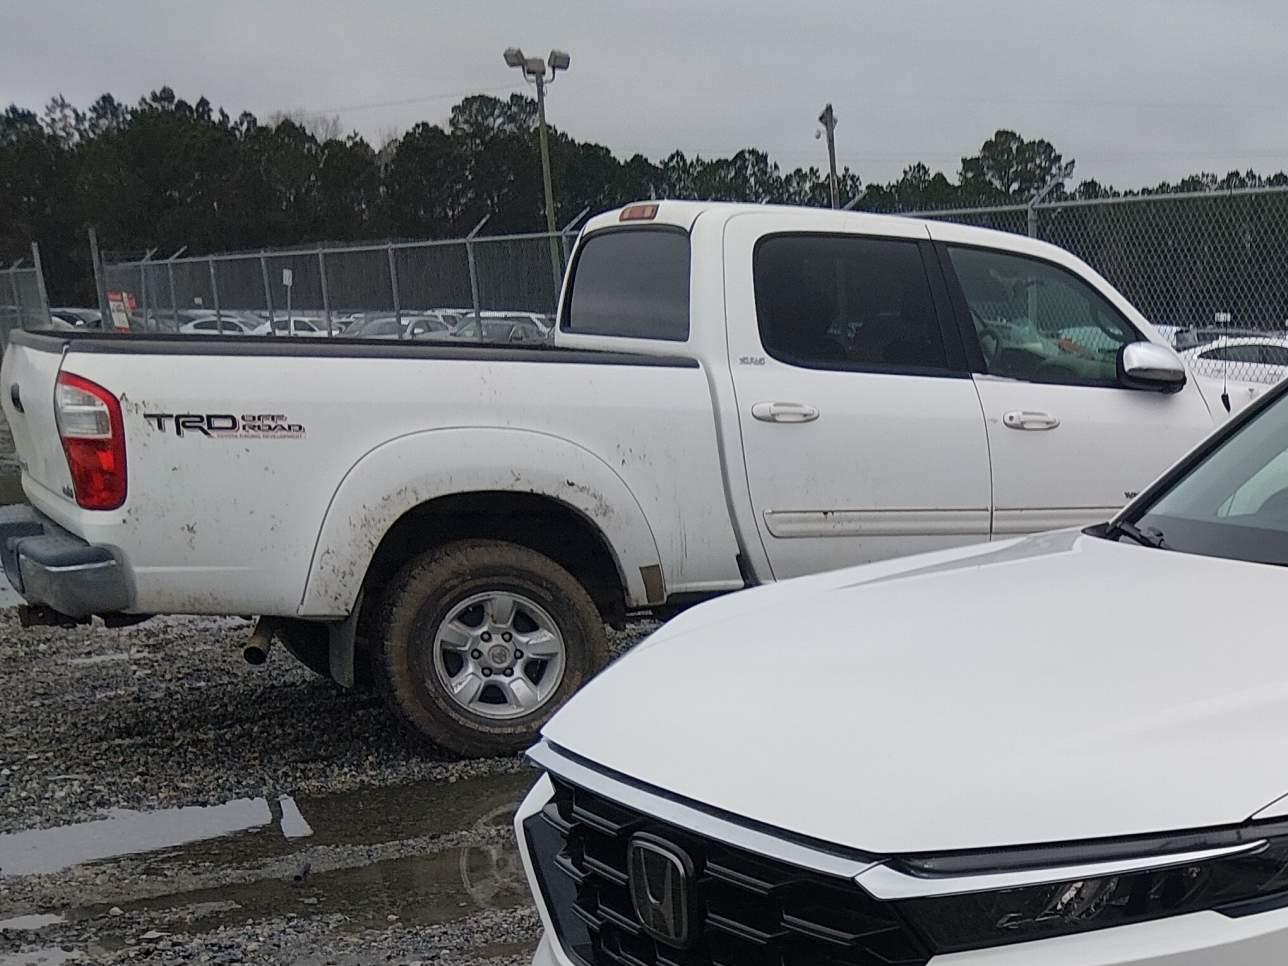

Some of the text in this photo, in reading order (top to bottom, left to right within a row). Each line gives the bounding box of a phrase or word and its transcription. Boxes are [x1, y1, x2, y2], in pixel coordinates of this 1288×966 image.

[143, 413, 239, 437] TRD
[241, 414, 286, 423] OFF
[241, 423, 305, 433] ROAD
